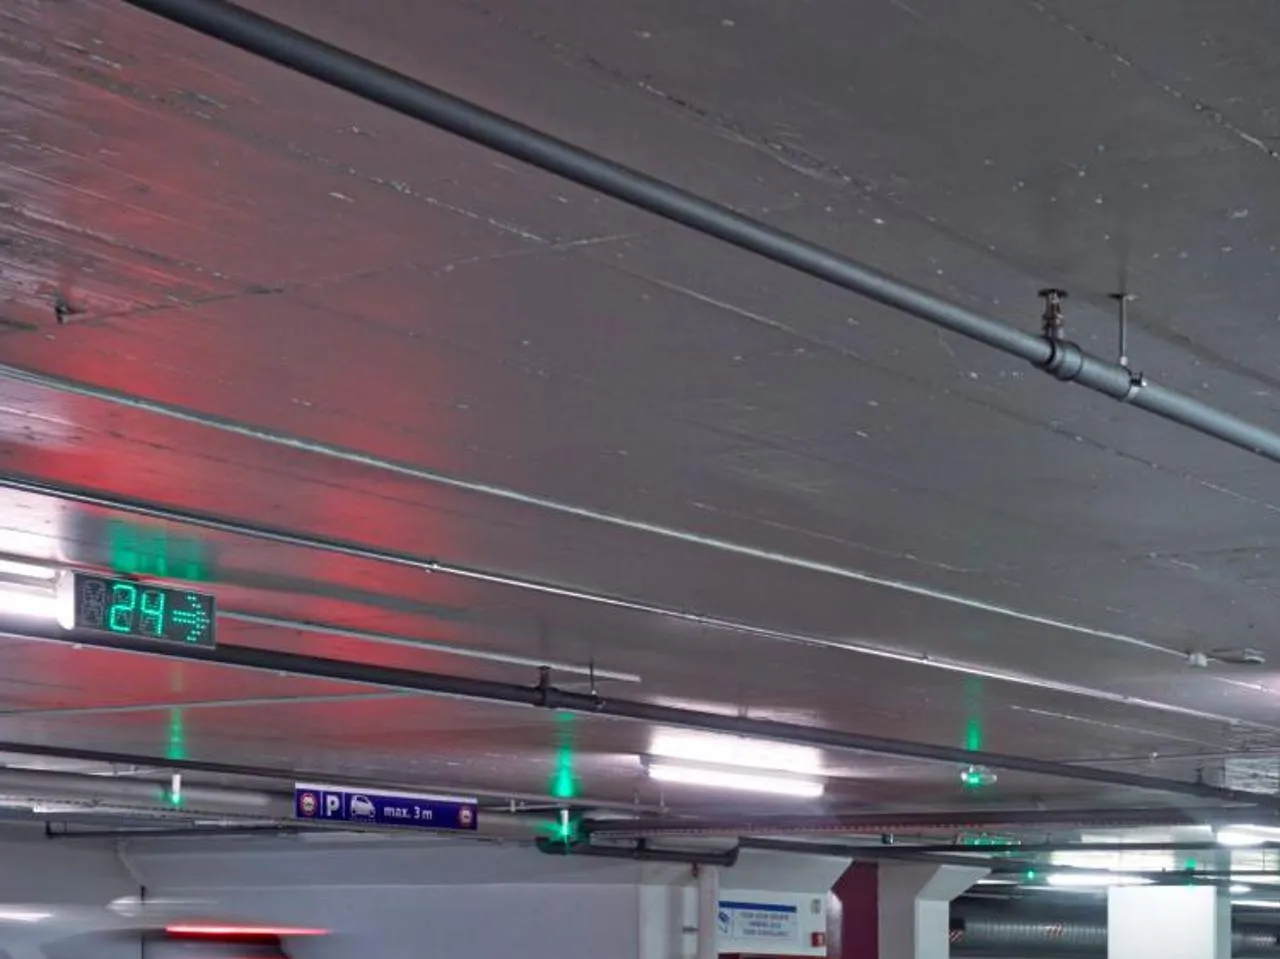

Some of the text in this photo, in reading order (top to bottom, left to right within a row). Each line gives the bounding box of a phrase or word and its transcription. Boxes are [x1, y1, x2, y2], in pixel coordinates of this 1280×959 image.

[110, 583, 165, 636] 24
[326, 794, 340, 817] P
[413, 805, 421, 820] 3
